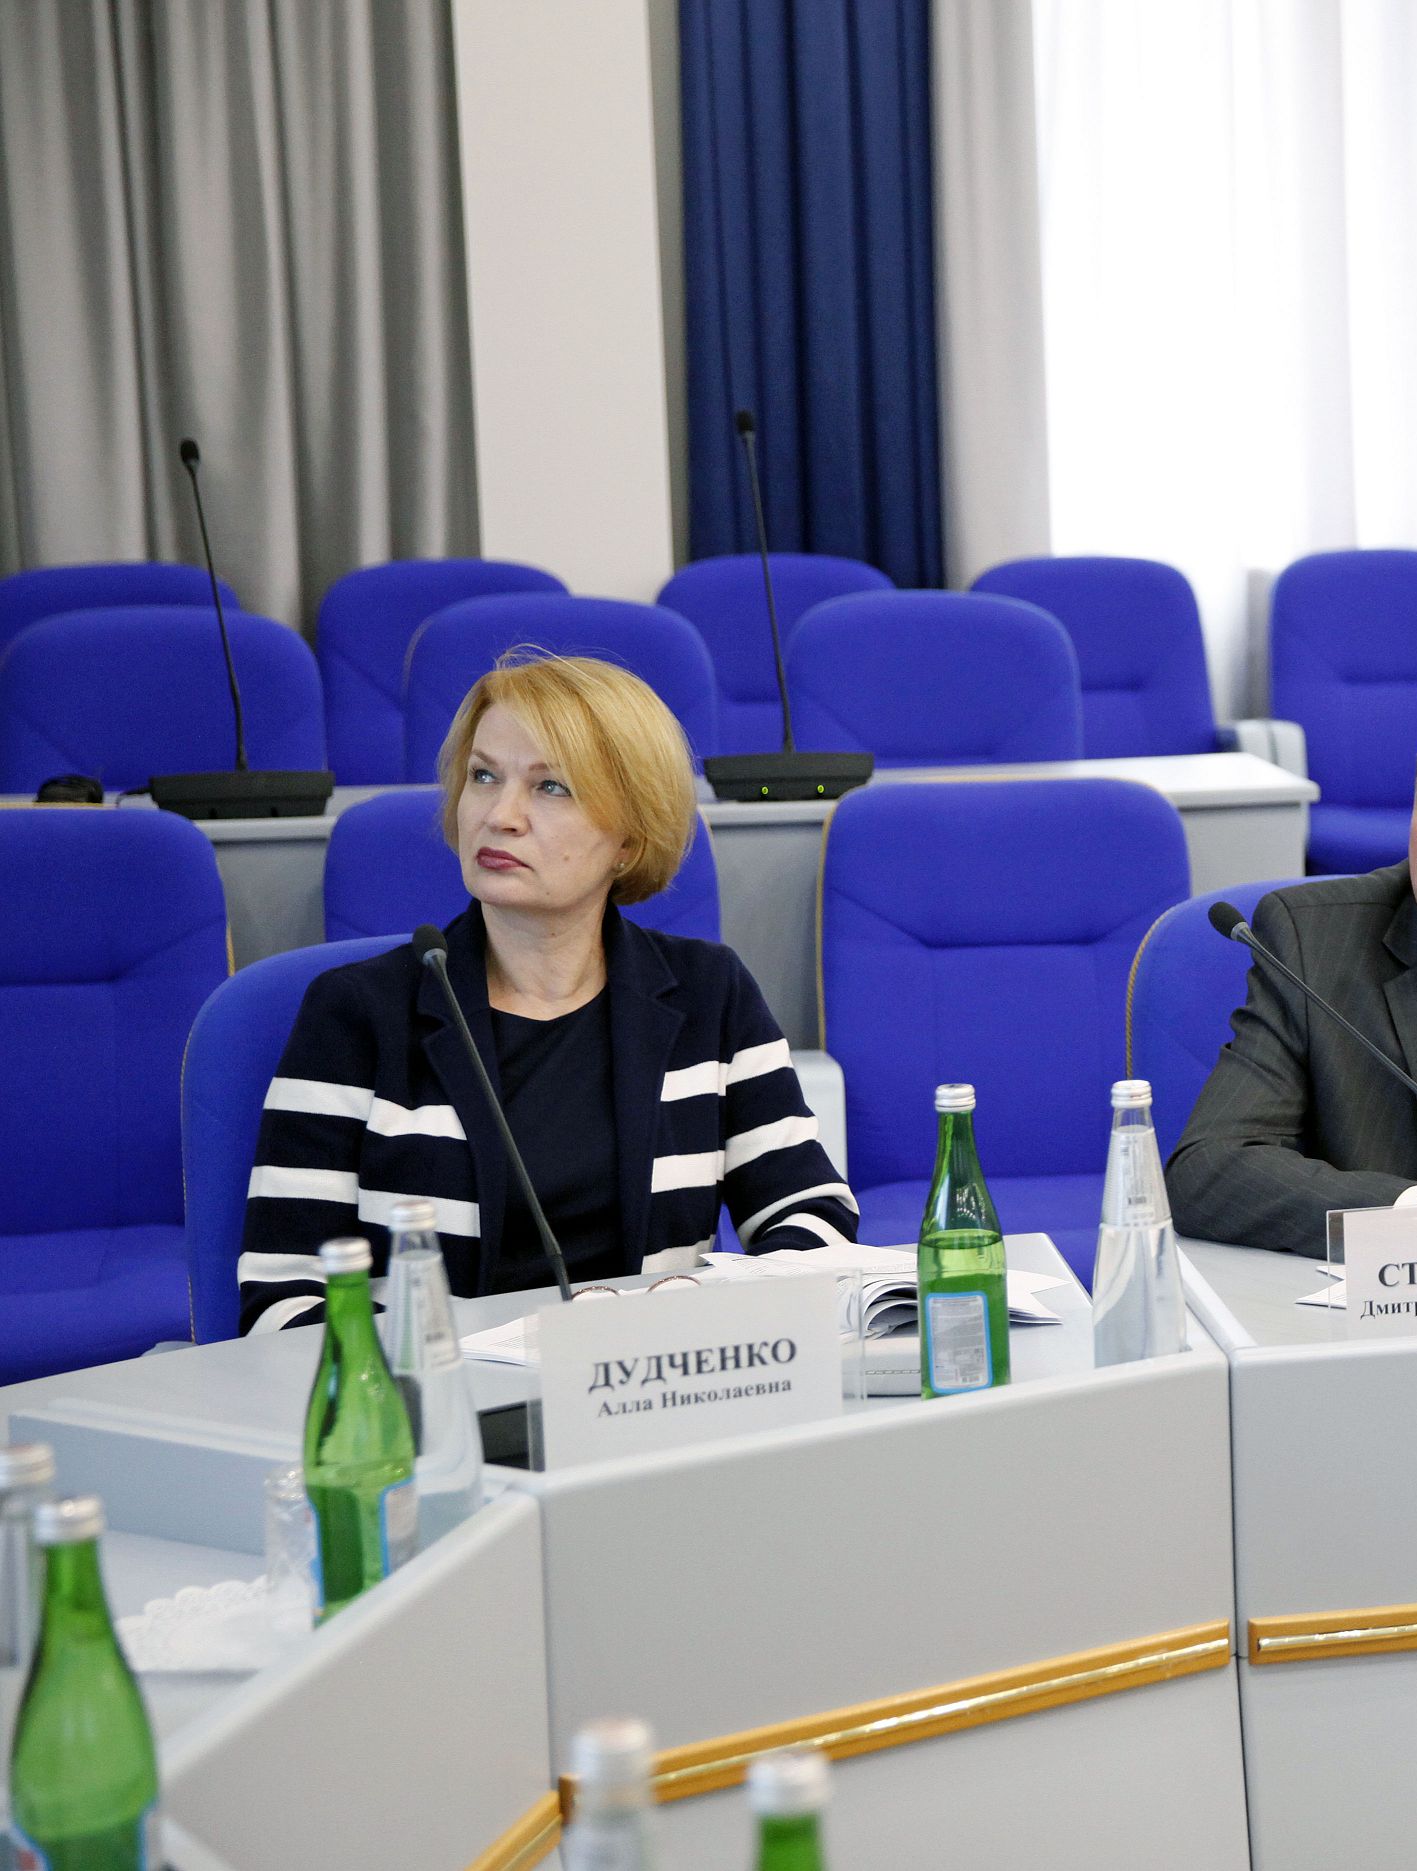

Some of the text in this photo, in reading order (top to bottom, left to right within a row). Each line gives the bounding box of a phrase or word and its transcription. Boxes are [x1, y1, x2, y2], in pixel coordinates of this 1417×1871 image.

[588, 1338, 797, 1393] ДУДЧЕНКО
[597, 1380, 793, 1418] Алла Николаевна
